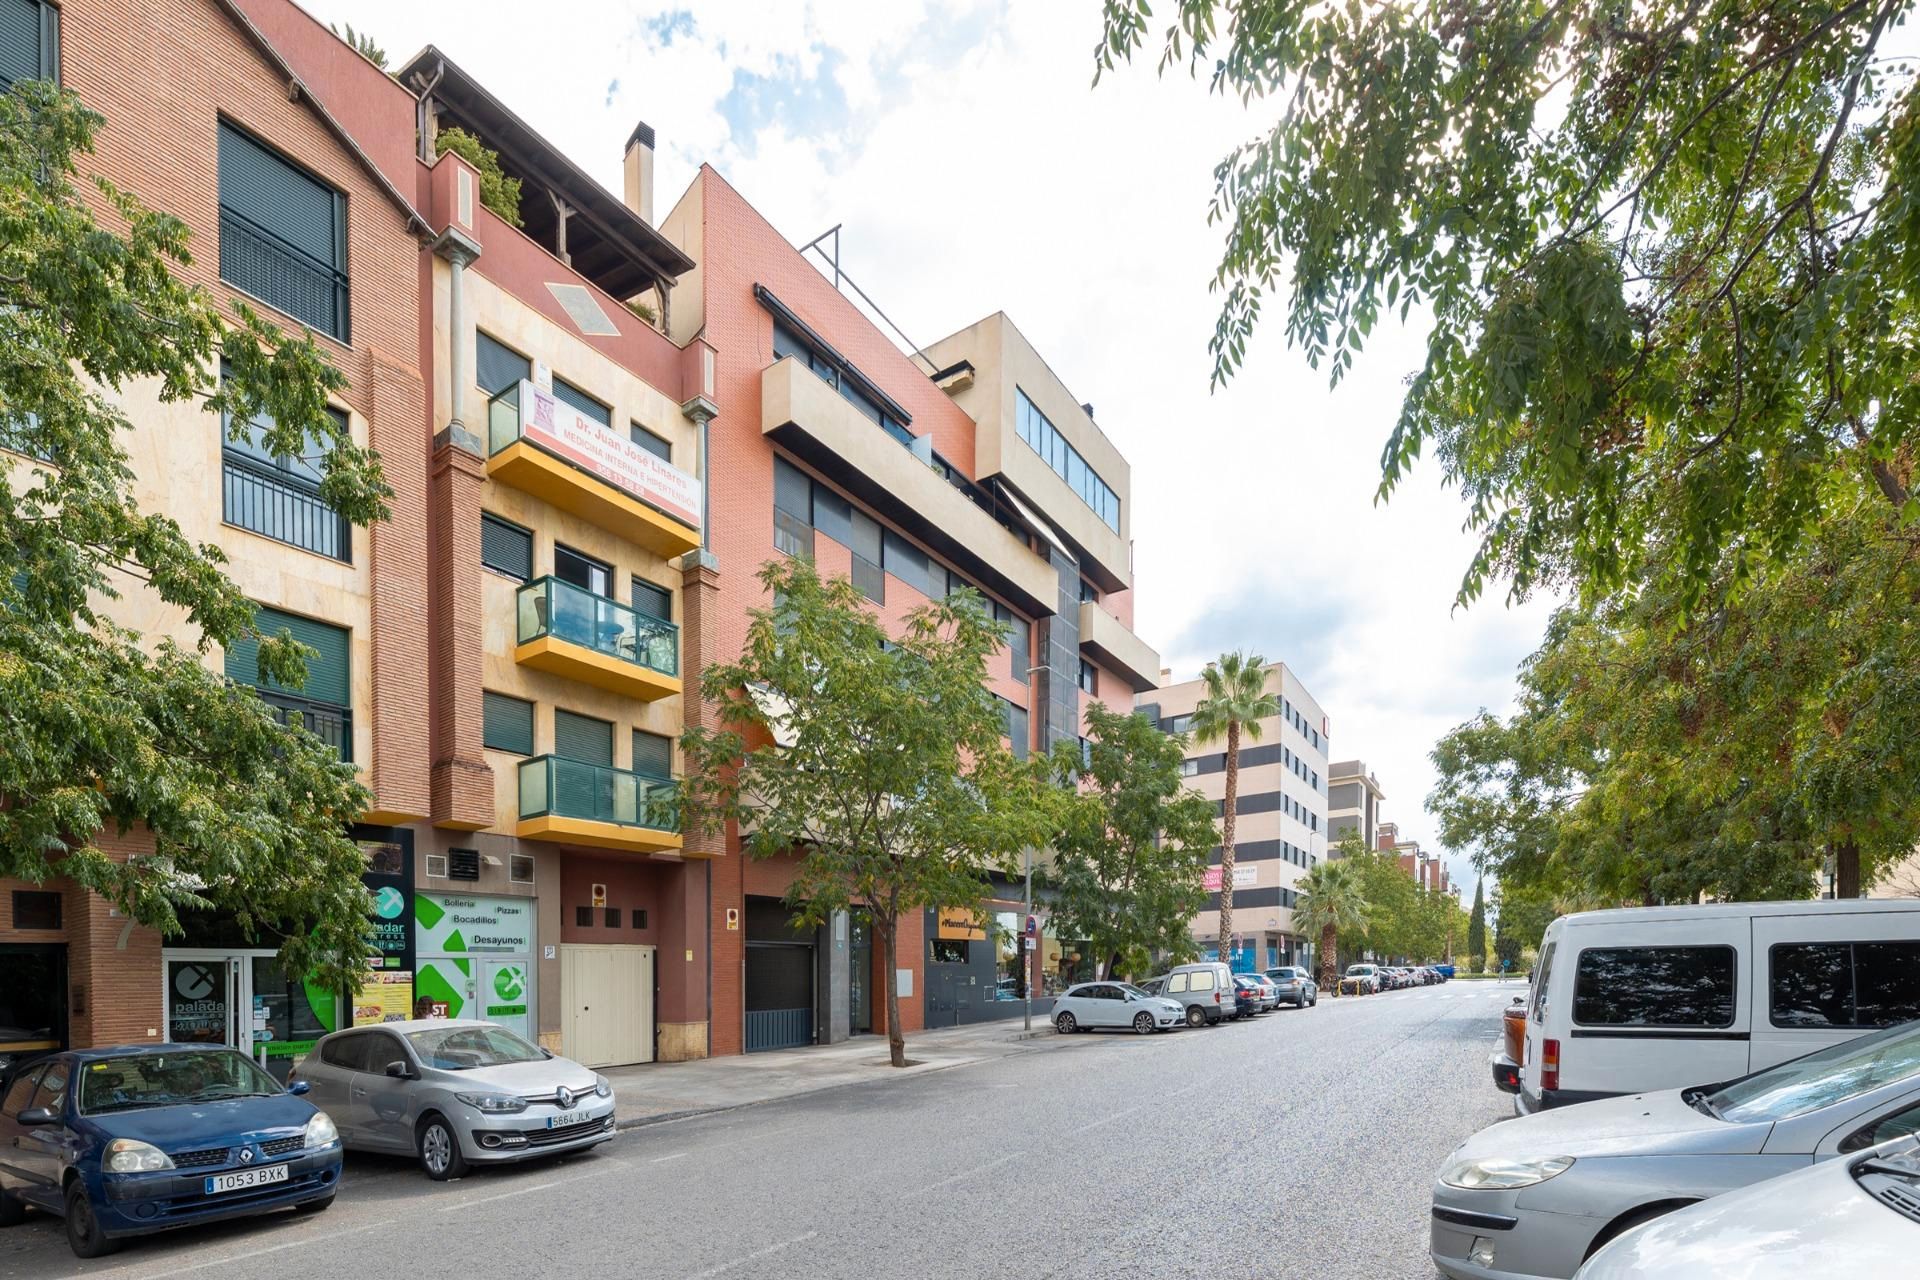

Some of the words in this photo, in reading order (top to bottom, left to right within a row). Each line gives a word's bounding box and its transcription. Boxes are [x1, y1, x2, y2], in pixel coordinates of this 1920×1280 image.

[564, 429, 603, 458] MEDICINA
[605, 452, 638, 477] INTERNA
[576, 416, 591, 435] Dr.
[595, 429, 621, 452] Juan
[624, 446, 648, 466] José
[652, 461, 687, 489] Linares
[497, 906, 519, 915] Pizzas
[373, 921, 405, 933] ladar
[453, 914, 497, 925] Bocadillos
[474, 935, 524, 946] Desayunos
[175, 1000, 225, 1015] palada
[553, 1113, 574, 1127] 5664
[576, 1111, 591, 1122] JLK
[219, 1172, 255, 1190] 1053
[260, 1167, 285, 1183] BXK
